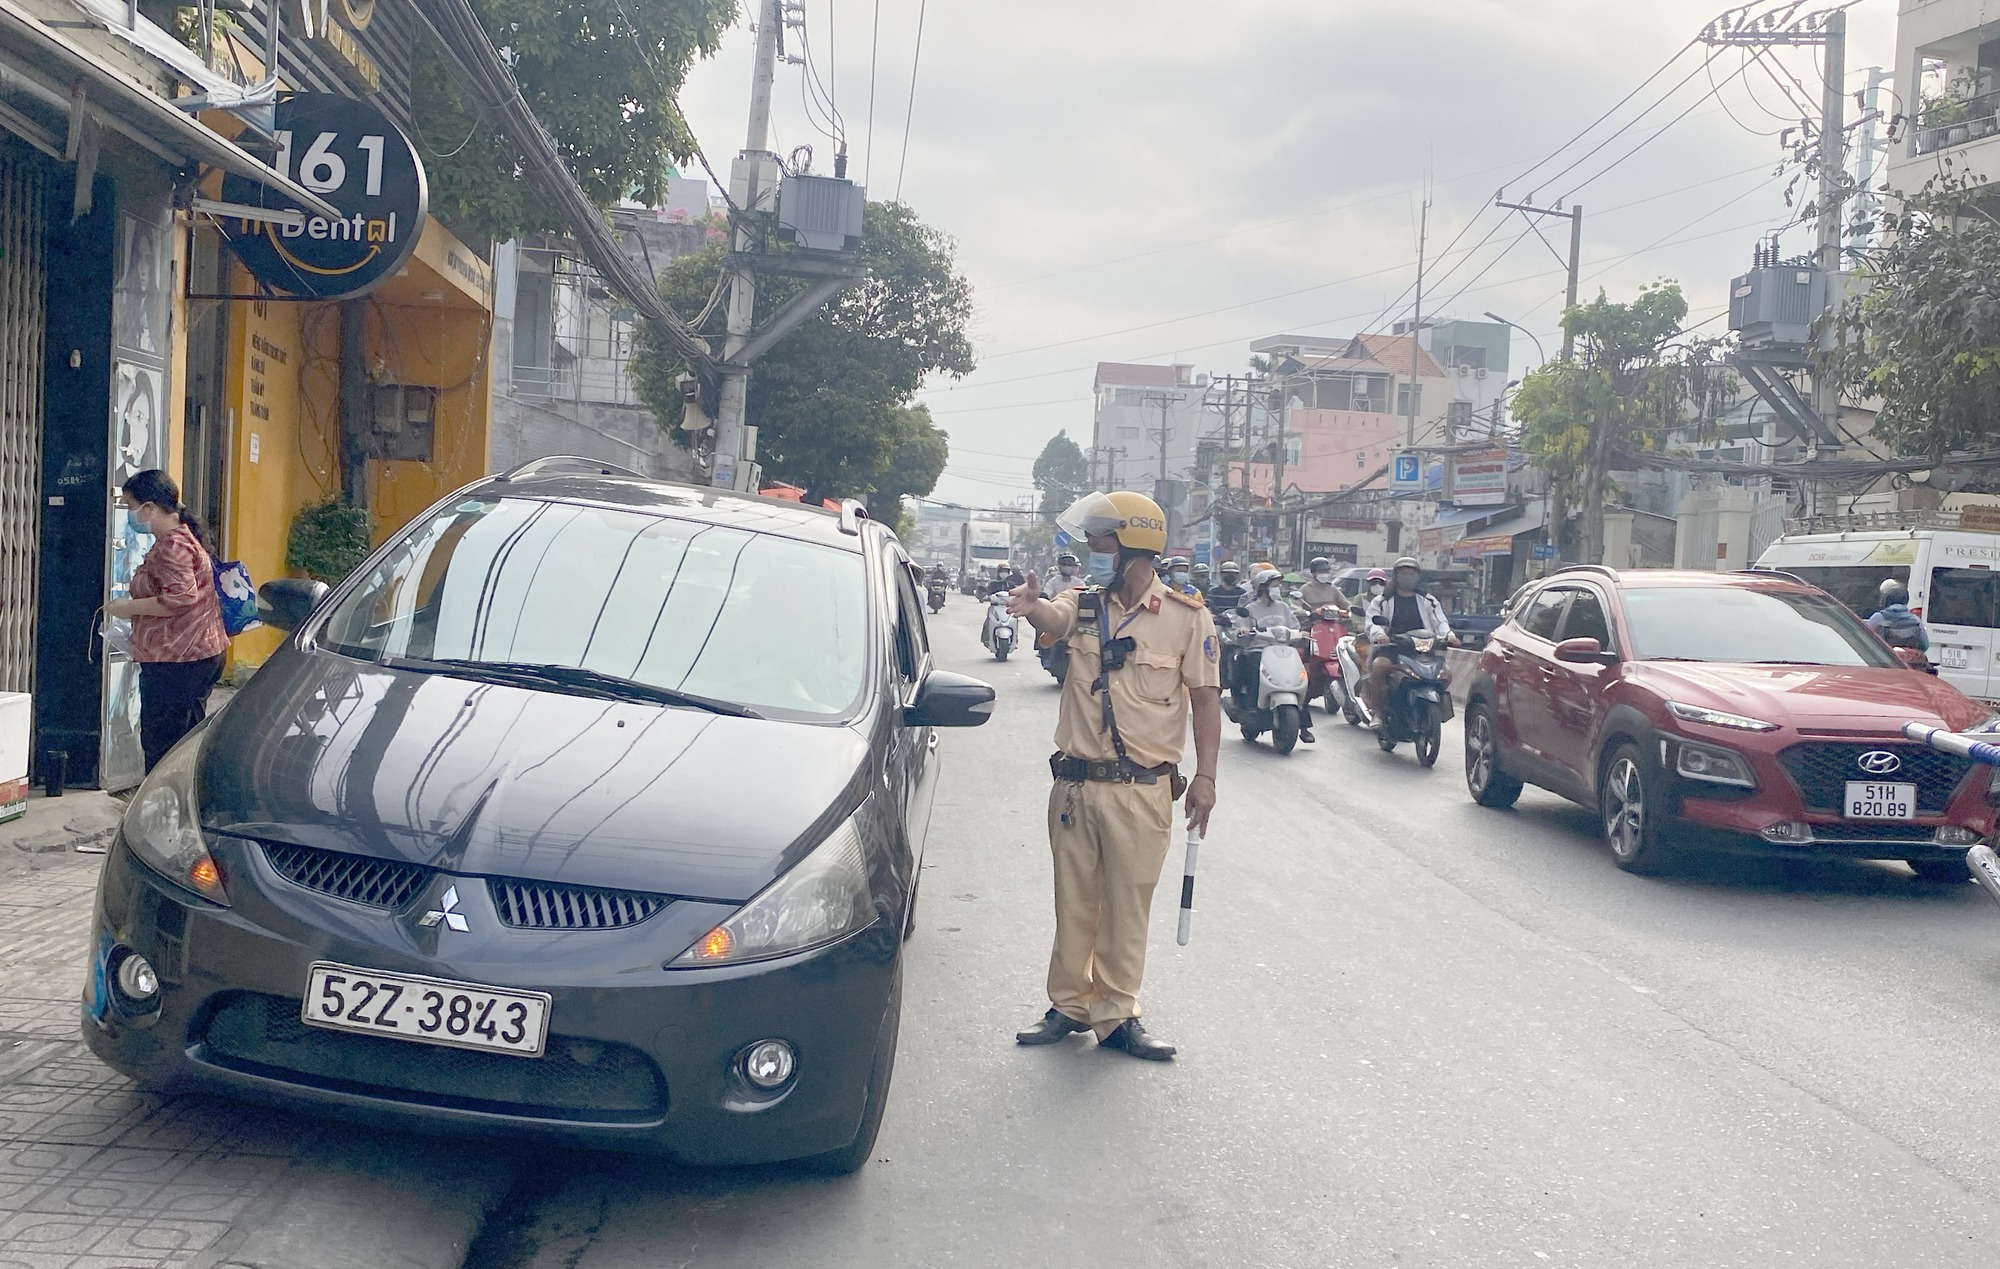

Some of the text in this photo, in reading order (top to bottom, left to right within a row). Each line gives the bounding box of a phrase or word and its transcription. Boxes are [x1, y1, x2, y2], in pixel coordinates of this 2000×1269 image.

[273, 130, 385, 196] 161
[1129, 516, 1164, 532] CSGT
[1324, 546, 1351, 554] MOBILE
[1945, 547, 2000, 558] PRESI
[1947, 649, 1962, 659] 51B
[1865, 785, 1896, 801] 51H
[1852, 801, 1907, 817] 820.89
[321, 974, 528, 1044] 52Z-3843
